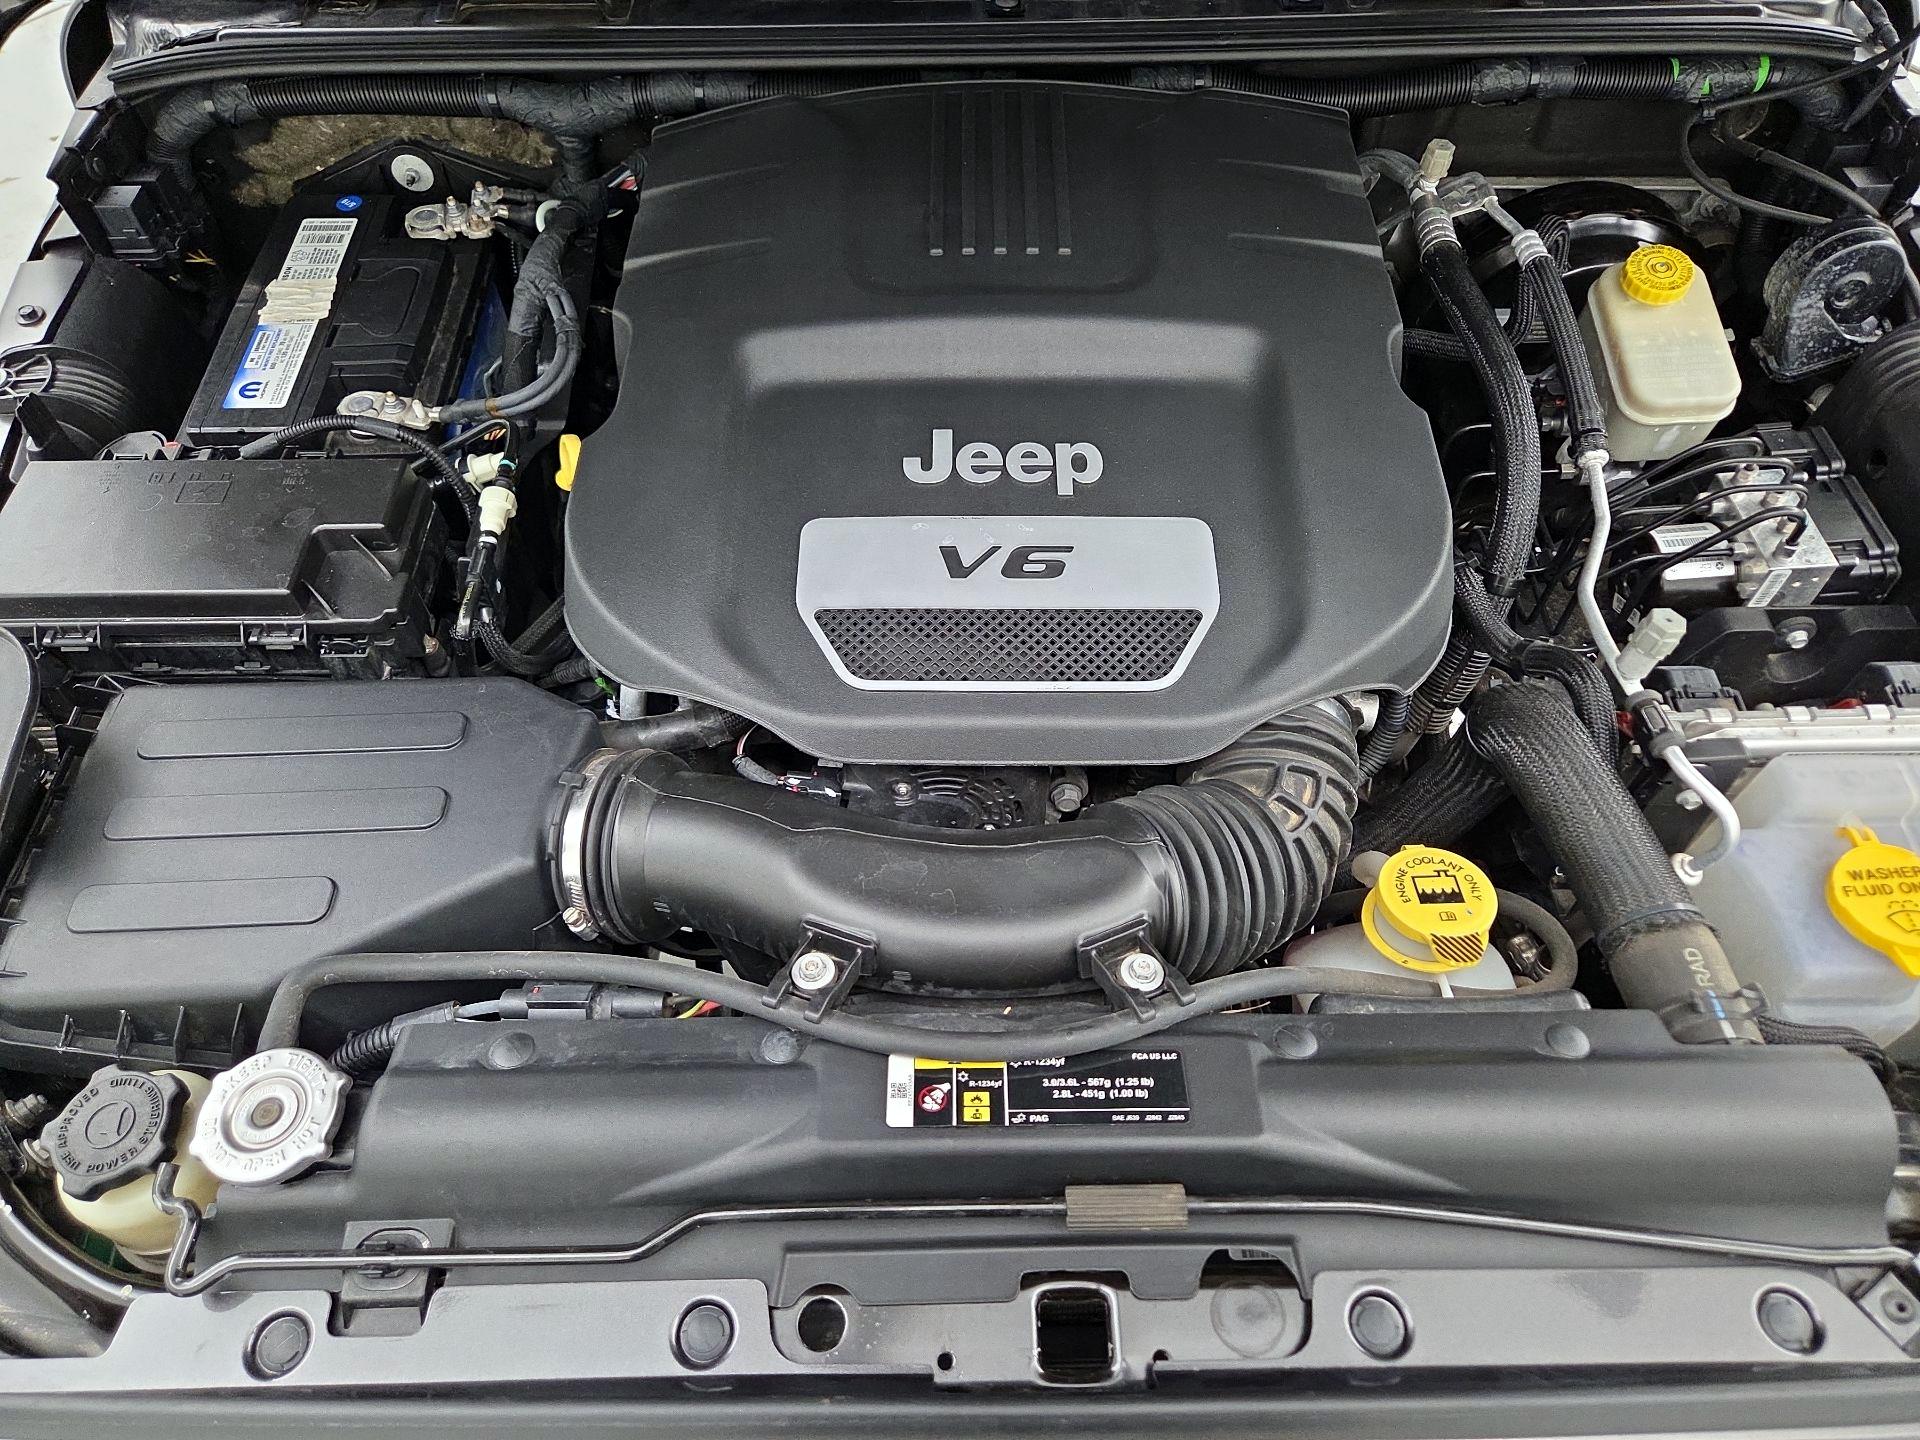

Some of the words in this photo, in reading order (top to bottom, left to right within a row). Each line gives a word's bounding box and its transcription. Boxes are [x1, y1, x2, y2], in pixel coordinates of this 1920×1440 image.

[903, 428, 1104, 496] Jeep
[938, 545, 1075, 579] V6
[1395, 867, 1412, 904] ENGINE
[1405, 856, 1465, 873] COOLANT
[1464, 874, 1482, 902] ONLY
[1846, 866, 1920, 880] WASHER
[1842, 884, 1894, 897] FLUID
[1682, 948, 1715, 986] RAD
[1131, 1052, 1148, 1060] FCA
[1149, 1052, 1161, 1060] US
[1162, 1052, 1178, 1060] LLC
[109, 1077, 145, 1090] FLUID
[225, 1055, 272, 1089] KEEP
[287, 1051, 328, 1103] TIGHT
[968, 1079, 1002, 1089] R-1234yf
[1042, 1078, 1080, 1087] 3.0/3.6L
[1087, 1078, 1111, 1088] 567g
[1115, 1077, 1139, 1088] (1.25
[1140, 1077, 1155, 1088] lb)
[1052, 1089, 1074, 1098] 2.8L
[1081, 1089, 1106, 1099] 451g
[1109, 1089, 1133, 1099] (1.00
[1134, 1089, 1149, 1099] lb)
[57, 1087, 100, 1149] APPROVED
[138, 1086, 162, 1145] STEERING
[1029, 1114, 1050, 1122] PAG
[241, 1149, 287, 1172] OPEN
[292, 1116, 322, 1150] HOT
[61, 1151, 82, 1171] USE
[86, 1146, 139, 1174] POWER
